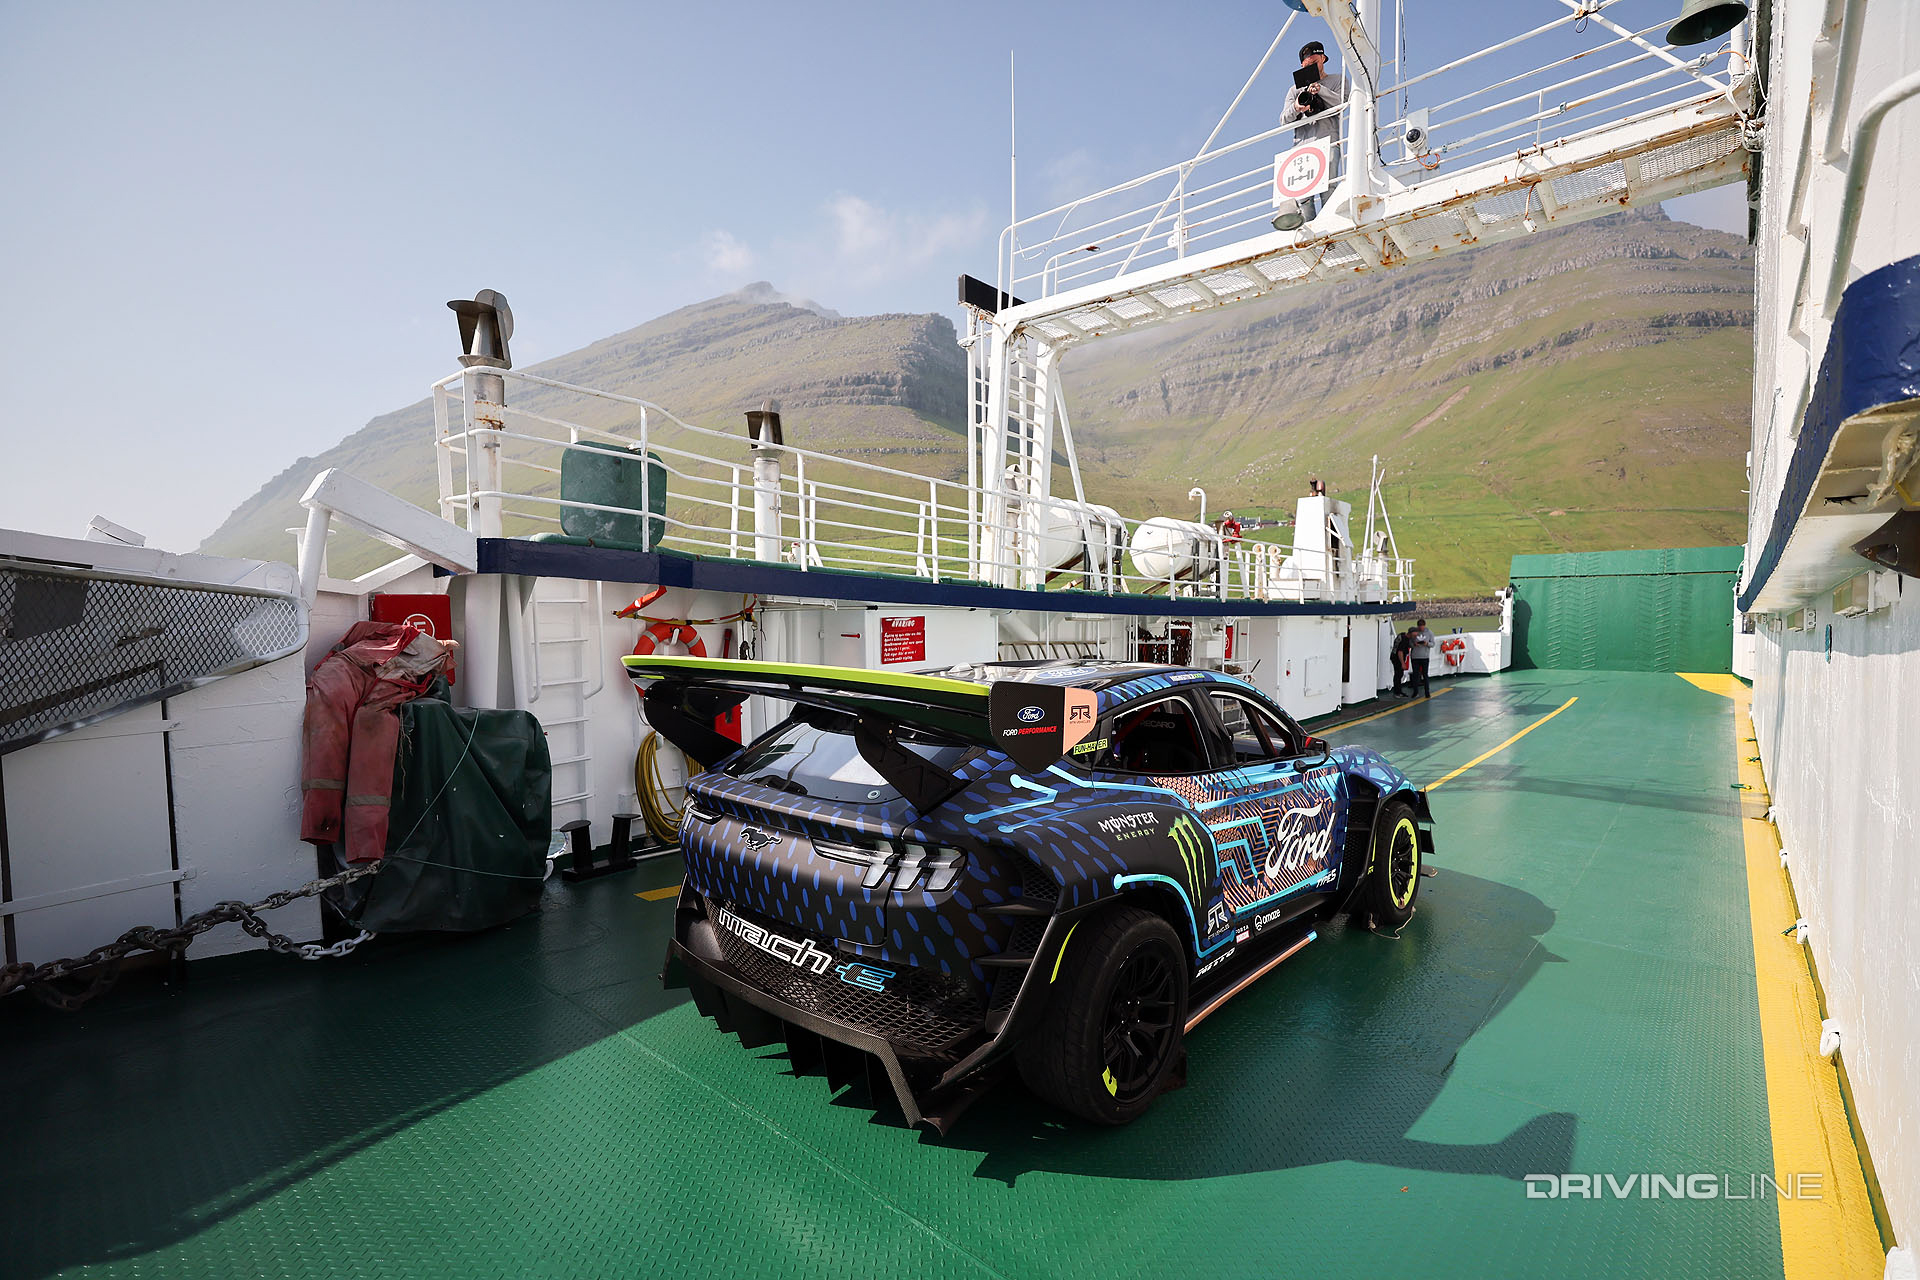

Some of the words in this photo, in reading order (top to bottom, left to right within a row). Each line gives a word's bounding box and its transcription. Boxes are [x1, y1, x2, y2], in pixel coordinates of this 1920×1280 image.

[1002, 729, 1018, 737] FORD
[1018, 726, 1058, 735] PERFORMANCE
[1097, 811, 1159, 834] MONSTER
[1115, 828, 1155, 841] ENERGY
[1264, 803, 1336, 879] Ford
